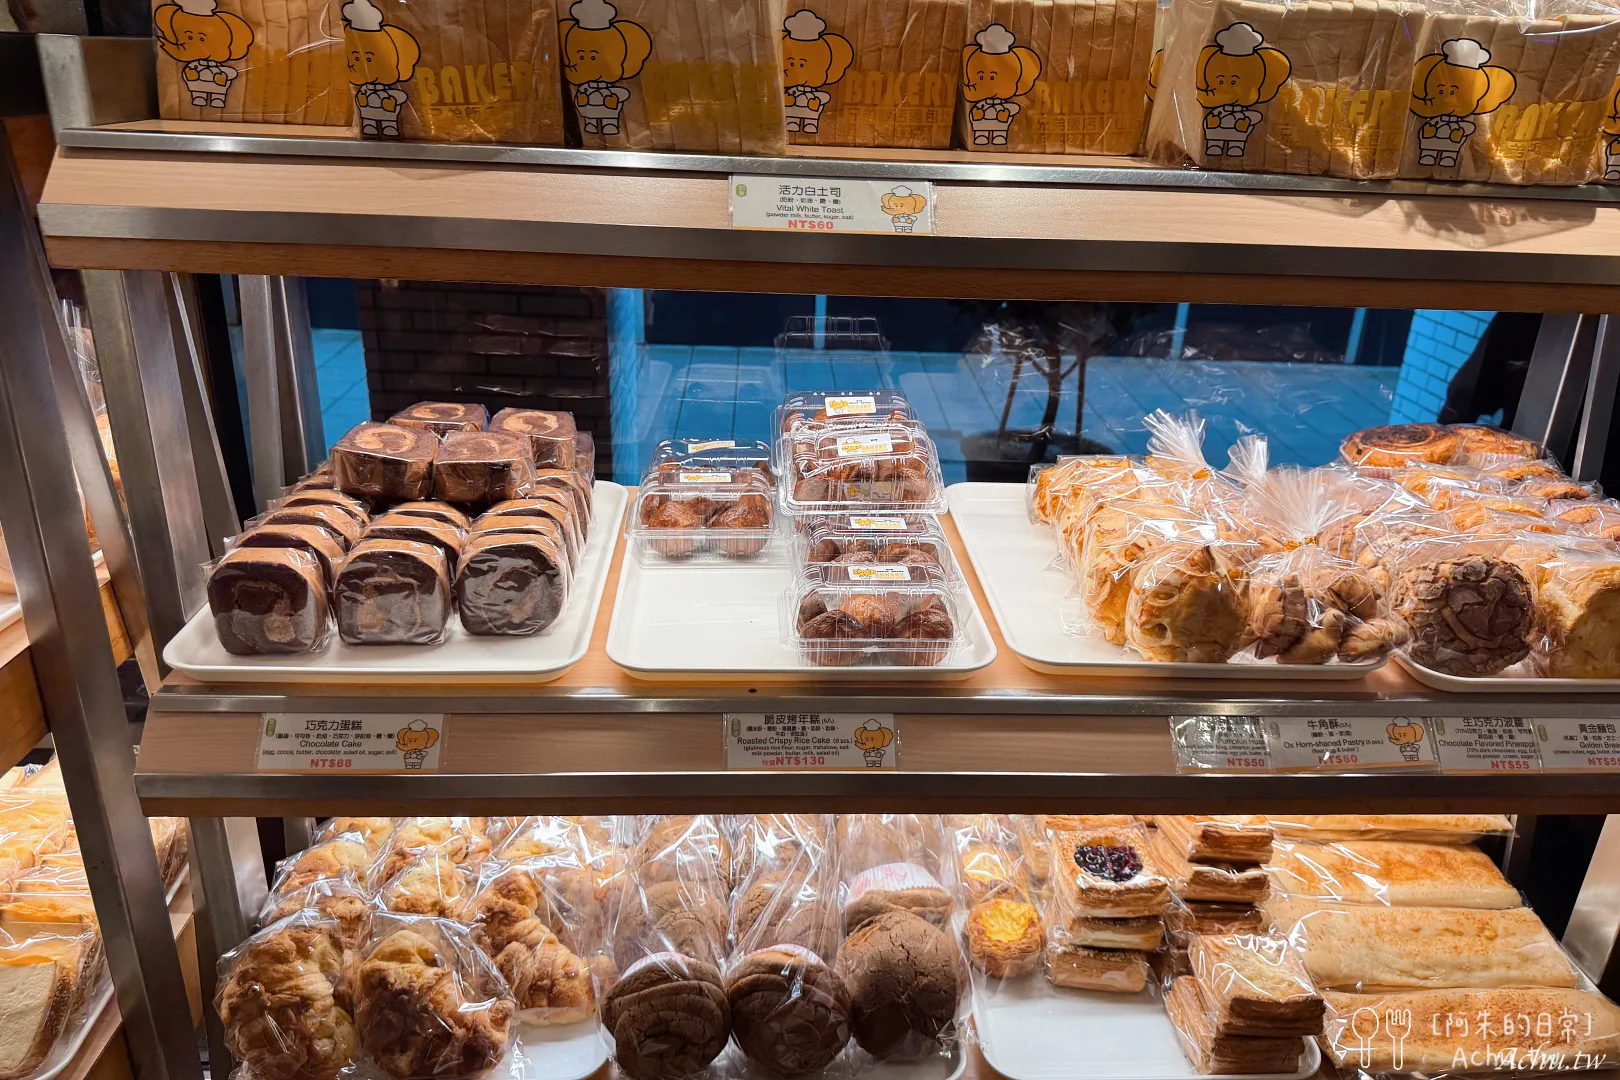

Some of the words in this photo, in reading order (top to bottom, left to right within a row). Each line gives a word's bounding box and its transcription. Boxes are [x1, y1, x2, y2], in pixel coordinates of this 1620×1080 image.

[845, 70, 959, 106] BAKERY
[1035, 80, 1144, 113] BAKER
[779, 184, 842, 198] 活力白土司
[776, 204, 794, 212] Vital
[797, 205, 819, 213] White
[821, 206, 844, 214] Toast
[787, 219, 834, 230] NT$60
[304, 719, 363, 731] 巧克力蛋糕
[299, 739, 340, 748] Chocolate
[341, 739, 362, 748] Cake
[737, 737, 768, 745] Roasted
[768, 737, 794, 746] Crispy
[794, 736, 811, 744] Rice
[811, 736, 831, 744] Cake
[1283, 741, 1295, 749] Ox
[1343, 738, 1365, 748] Pastry
[1438, 739, 1474, 747] Chocolate
[1475, 739, 1505, 747] Flavored
[1579, 741, 1603, 749] Golden
[310, 758, 352, 768] NT$68
[1227, 758, 1265, 767] NT$50
[1317, 754, 1359, 765] NT$60
[1490, 760, 1530, 769] NT$55
